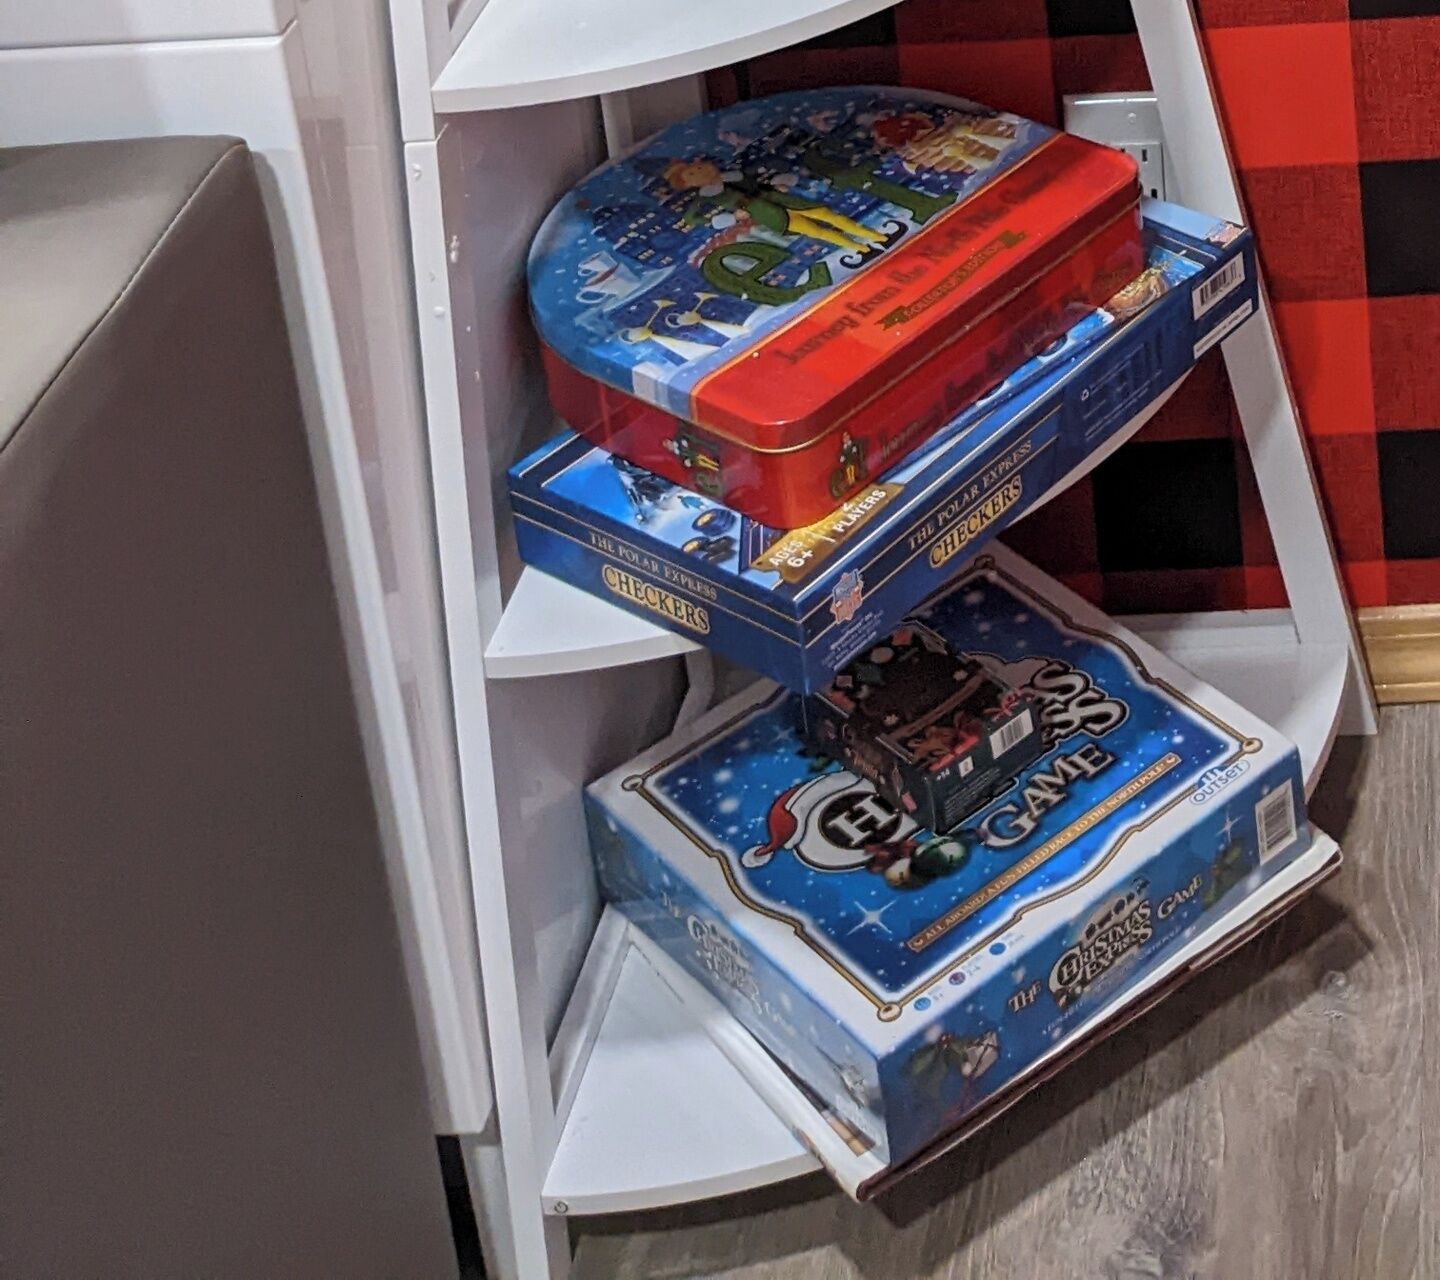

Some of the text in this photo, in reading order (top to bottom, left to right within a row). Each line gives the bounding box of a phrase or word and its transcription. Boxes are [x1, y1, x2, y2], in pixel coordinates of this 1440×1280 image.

[847, 287, 893, 322] from
[832, 488, 888, 533] PLAYERS
[909, 439, 1033, 550] THE POLAR EXPRESS
[931, 476, 1022, 566] CHECKERS
[589, 530, 718, 601] THE POLAR EXPRESS
[768, 539, 804, 566] AGES
[787, 549, 814, 569] 6+
[603, 565, 710, 632] CHECKERS
[980, 742, 1116, 848] GAME
[1156, 873, 1205, 920] GAME
[1049, 898, 1152, 994] CHRISTMAS
[1083, 918, 1154, 984] EXPRESS
[1008, 979, 1043, 1015] THE
